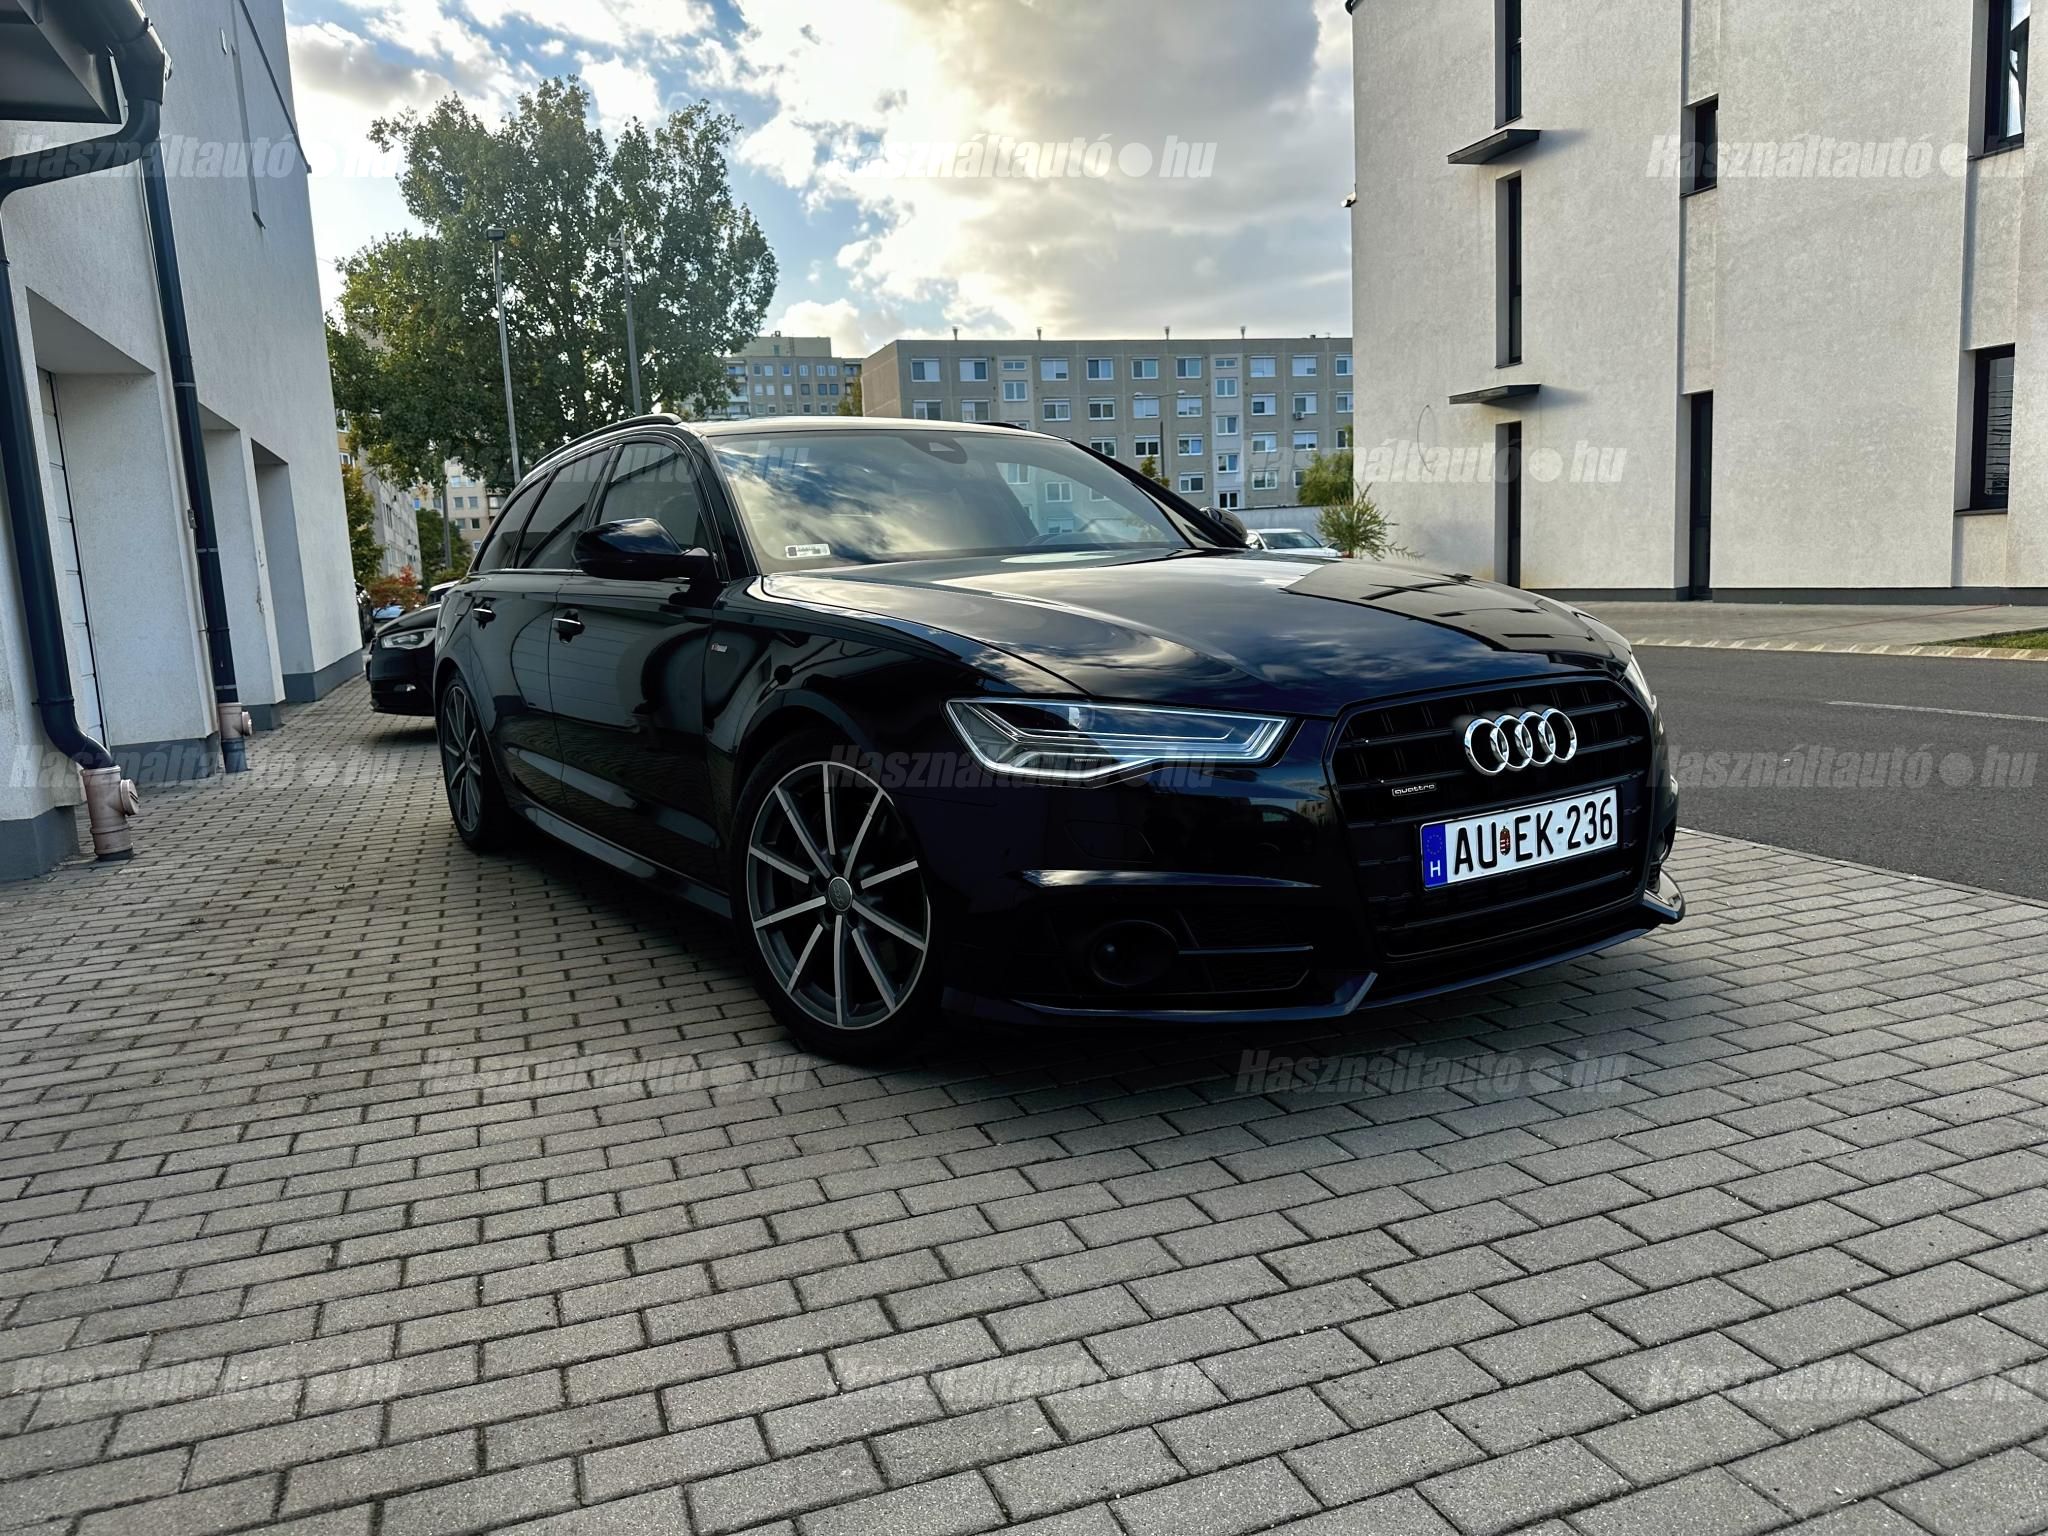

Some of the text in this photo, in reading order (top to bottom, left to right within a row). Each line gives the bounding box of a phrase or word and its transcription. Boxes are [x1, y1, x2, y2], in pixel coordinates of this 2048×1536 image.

[1394, 784, 1435, 795] quattro
[1454, 822, 1498, 875] AU
[1429, 860, 1441, 877] H
